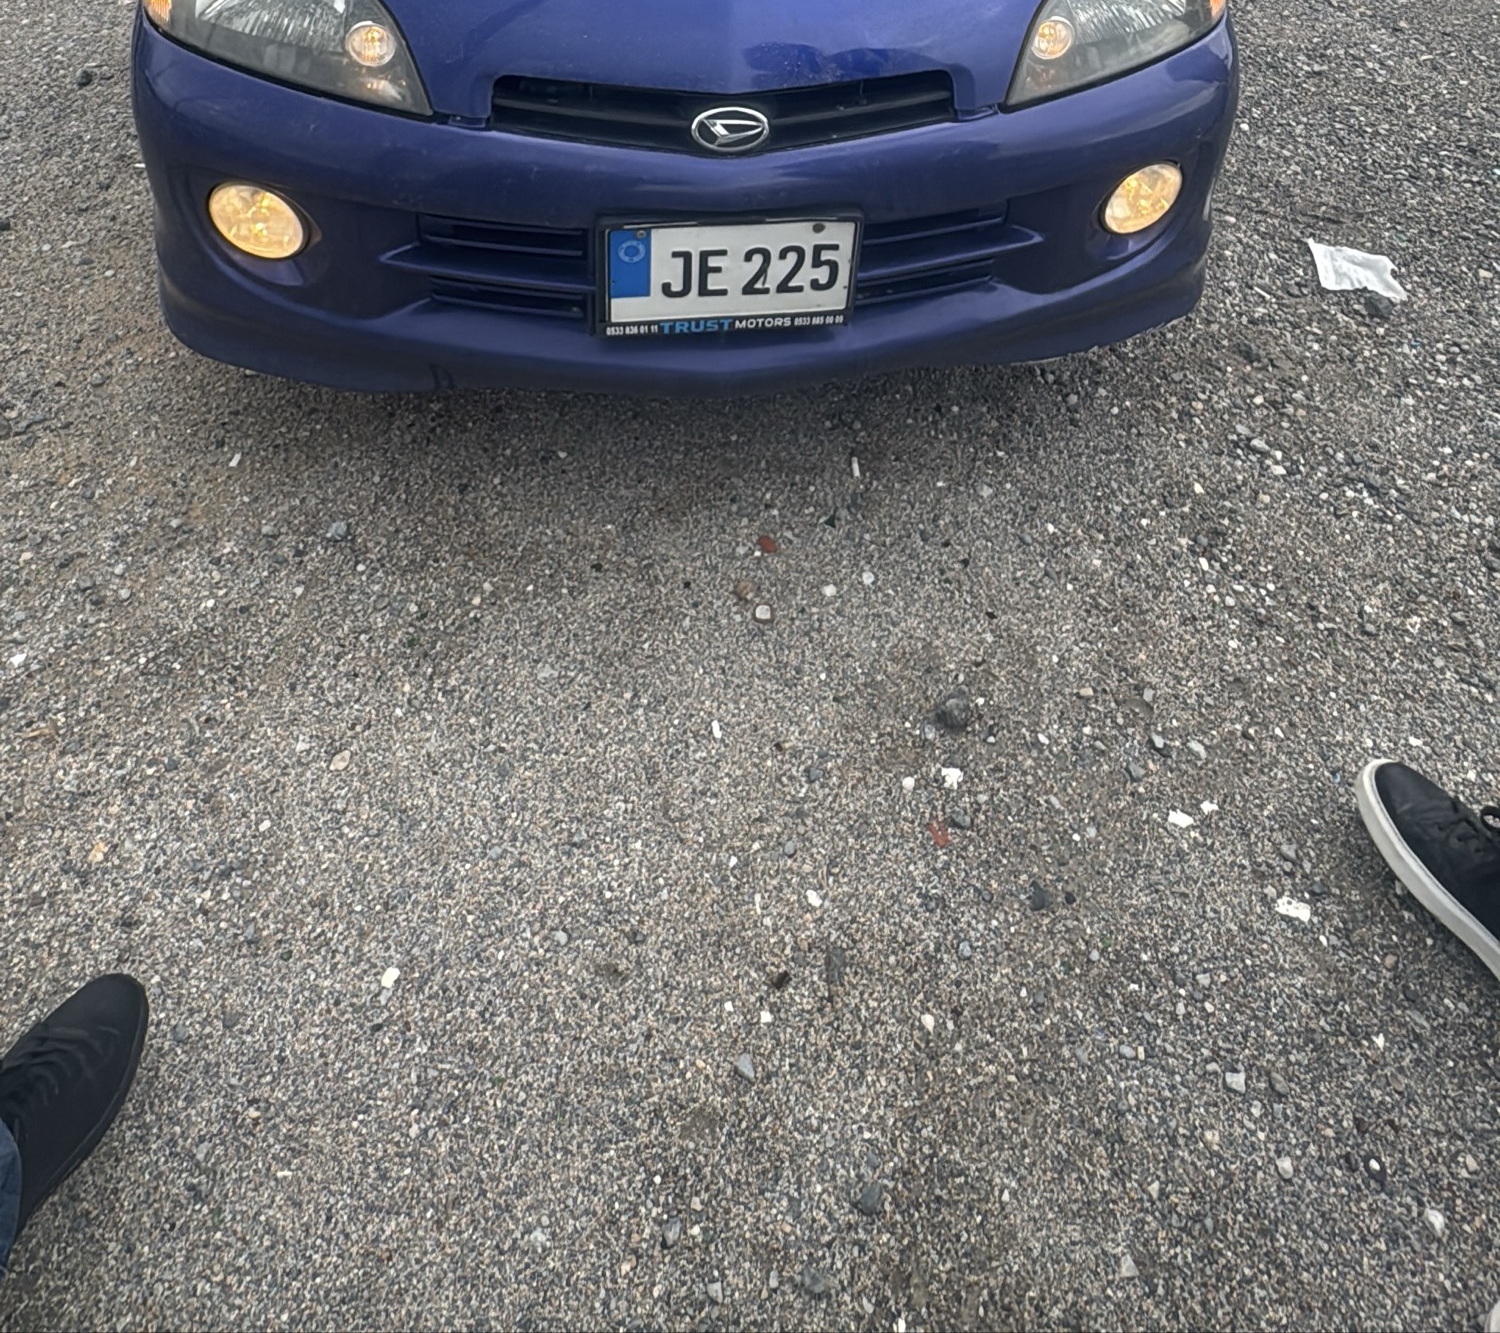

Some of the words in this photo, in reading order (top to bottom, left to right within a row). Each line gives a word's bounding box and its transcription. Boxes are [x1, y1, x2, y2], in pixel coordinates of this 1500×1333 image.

[661, 249, 729, 298] JE
[741, 244, 840, 295] 225
[660, 319, 733, 335] TRUST
[734, 317, 791, 330] MOTORS
